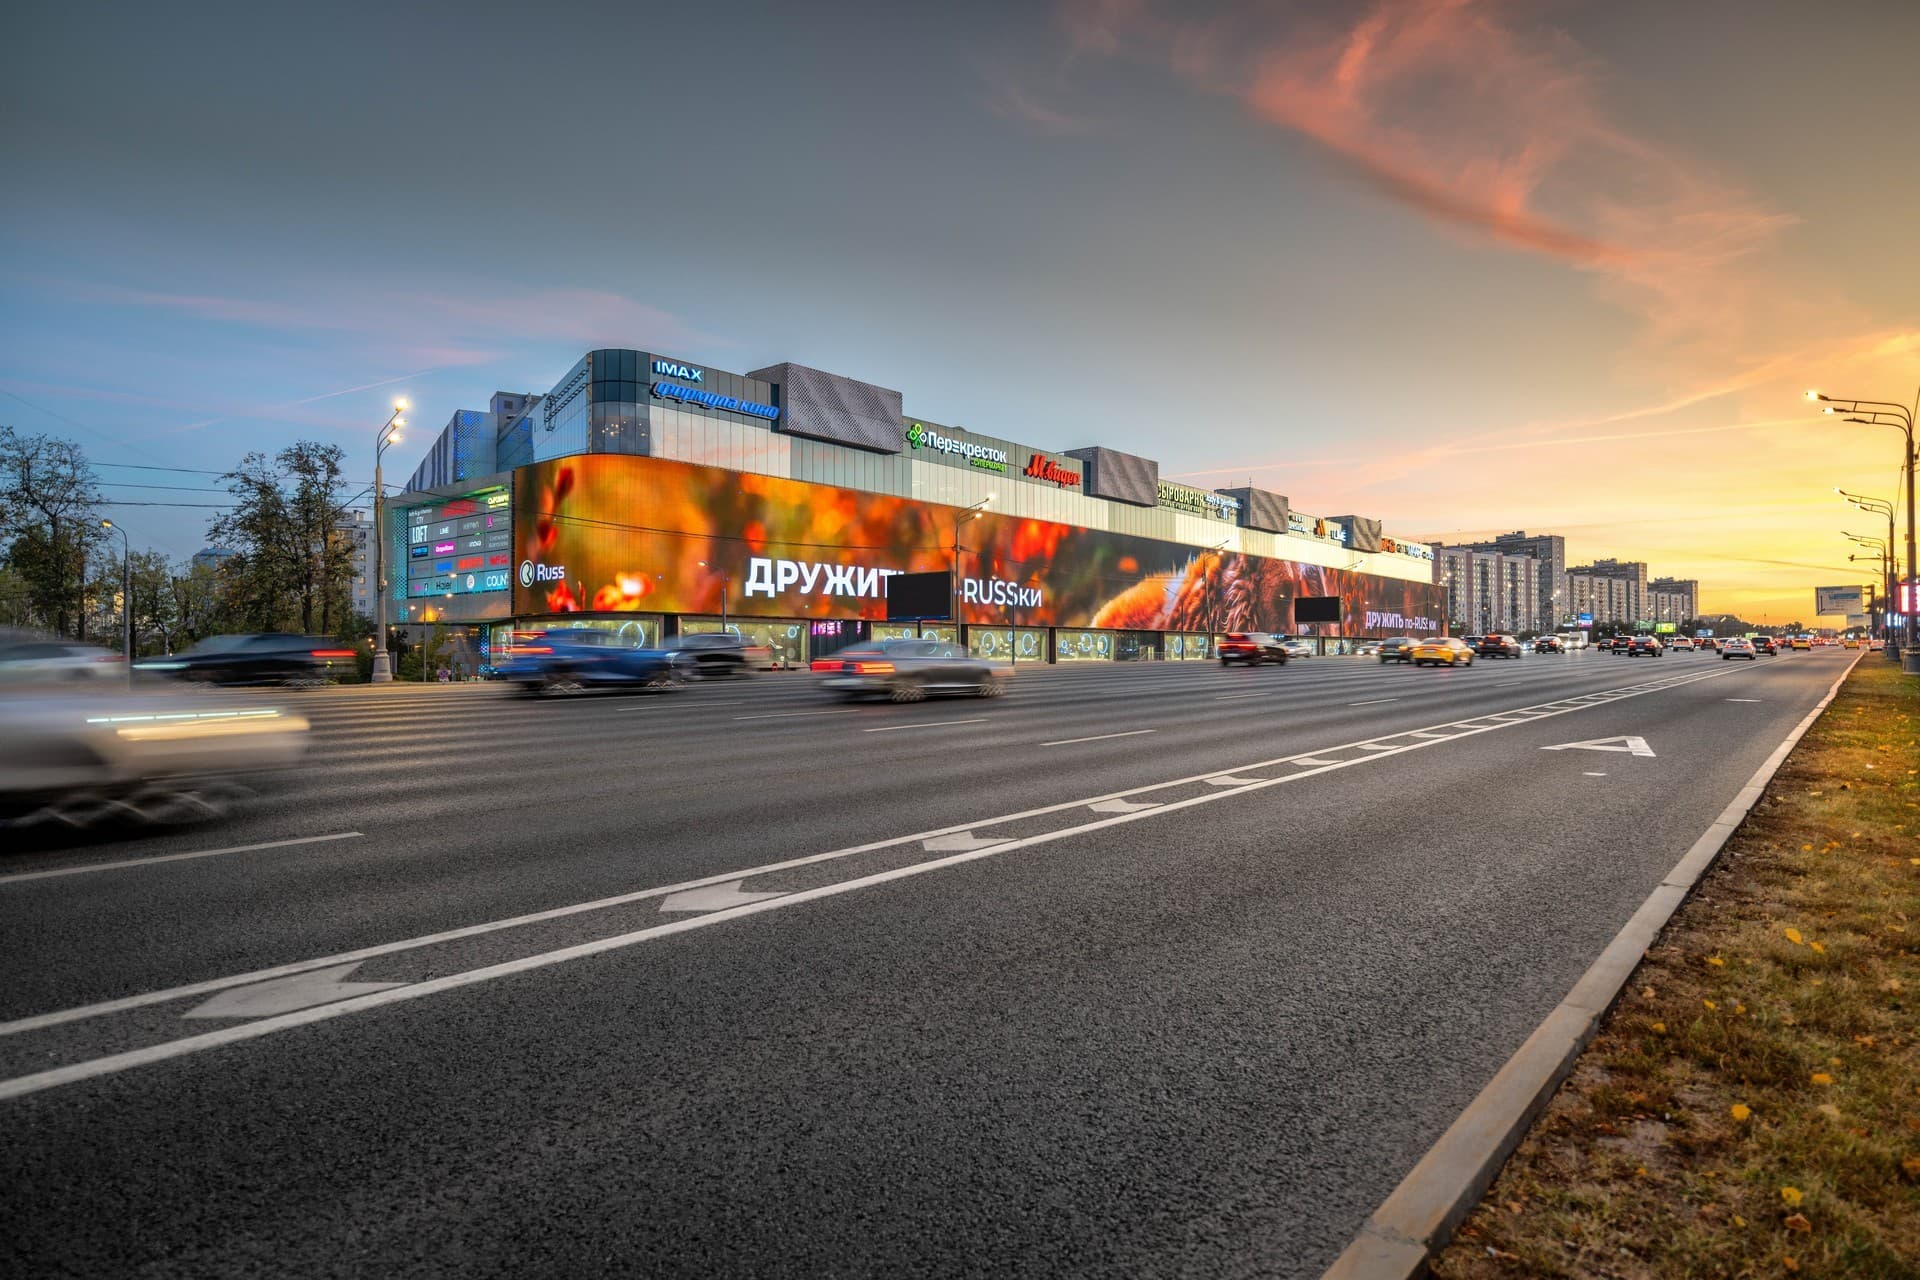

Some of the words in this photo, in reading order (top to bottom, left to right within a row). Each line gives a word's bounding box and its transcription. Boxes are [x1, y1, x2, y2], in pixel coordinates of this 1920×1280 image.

[654, 361, 703, 381] IMAX
[656, 382, 738, 407] формула
[740, 400, 780, 418] кино
[412, 525, 428, 544] LOFT
[537, 563, 565, 581] Russ
[745, 556, 904, 598] ДРУЖИТ
[955, 577, 1043, 608] -RUSSки
[1365, 611, 1404, 630] ДРУЖИТЬ
